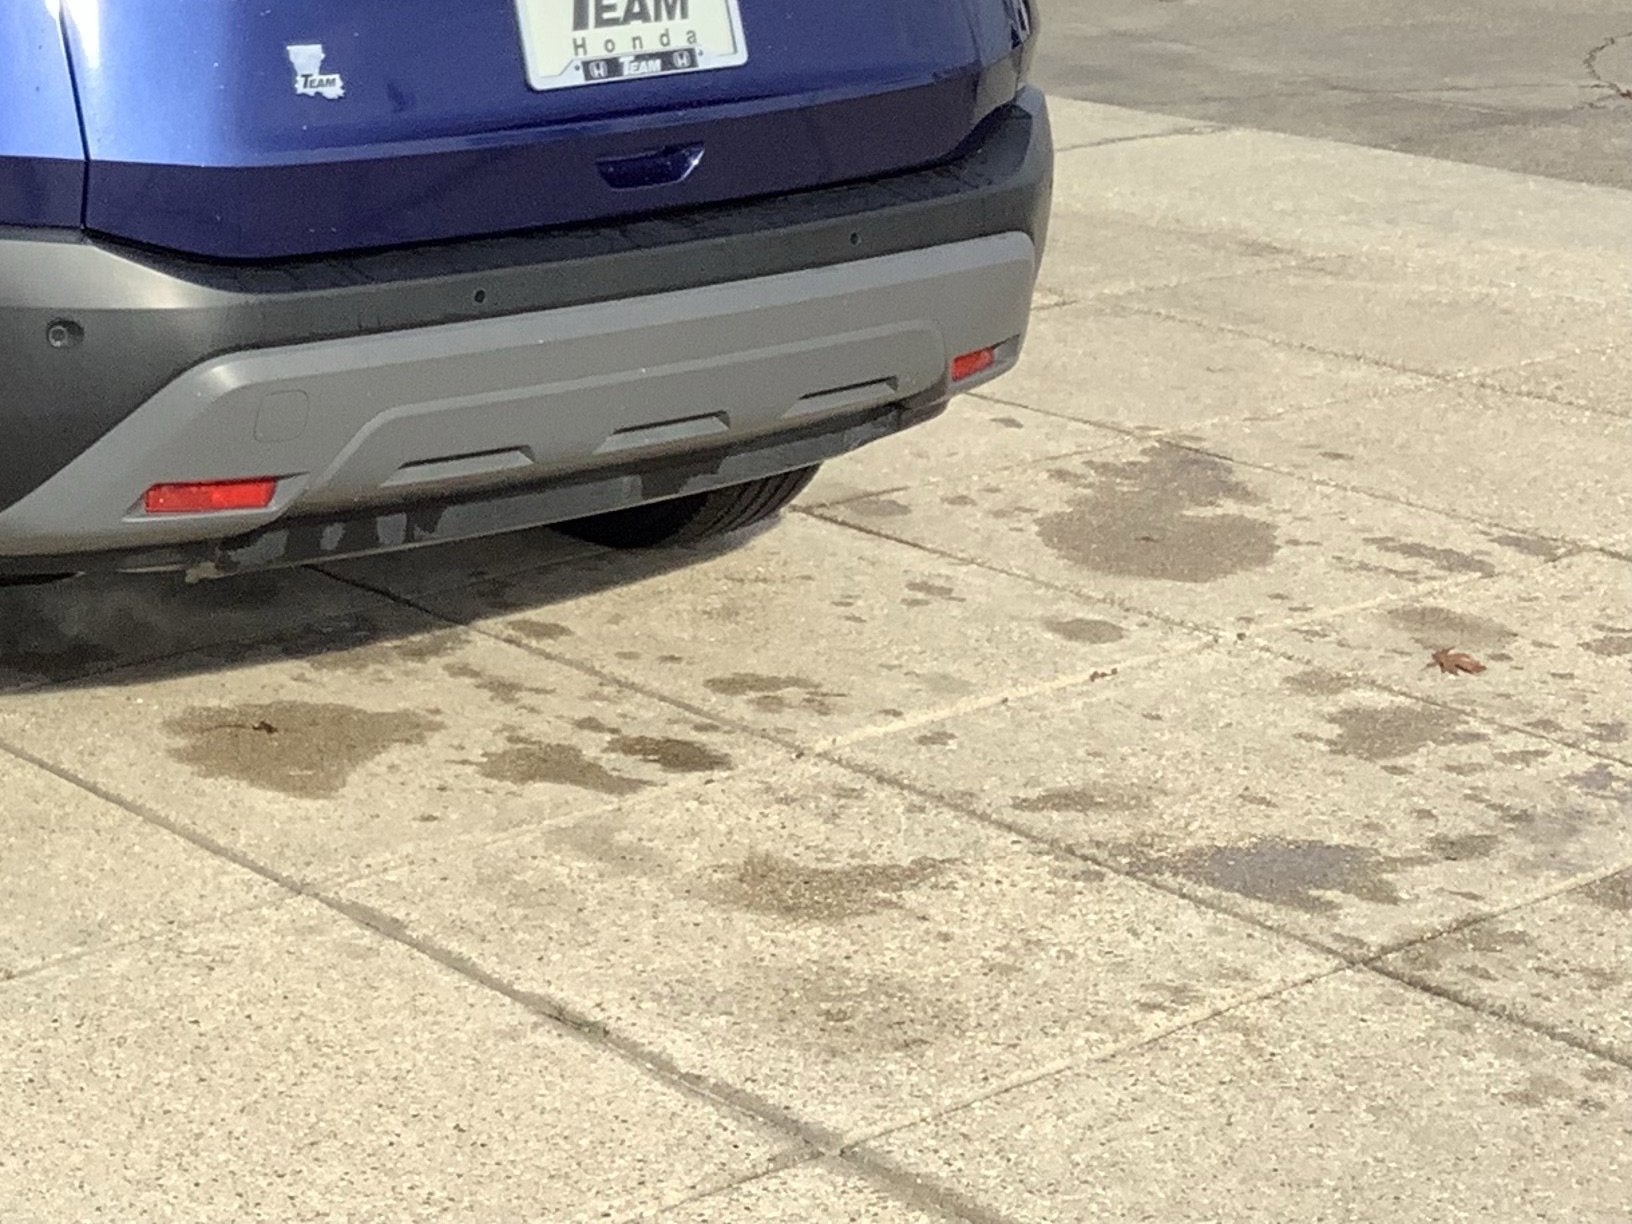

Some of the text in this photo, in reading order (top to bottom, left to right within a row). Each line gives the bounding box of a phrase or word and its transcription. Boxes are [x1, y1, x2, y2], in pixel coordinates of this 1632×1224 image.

[571, 28, 699, 57] Honda
[618, 55, 663, 77] TEAM
[300, 73, 337, 89] TEAM
